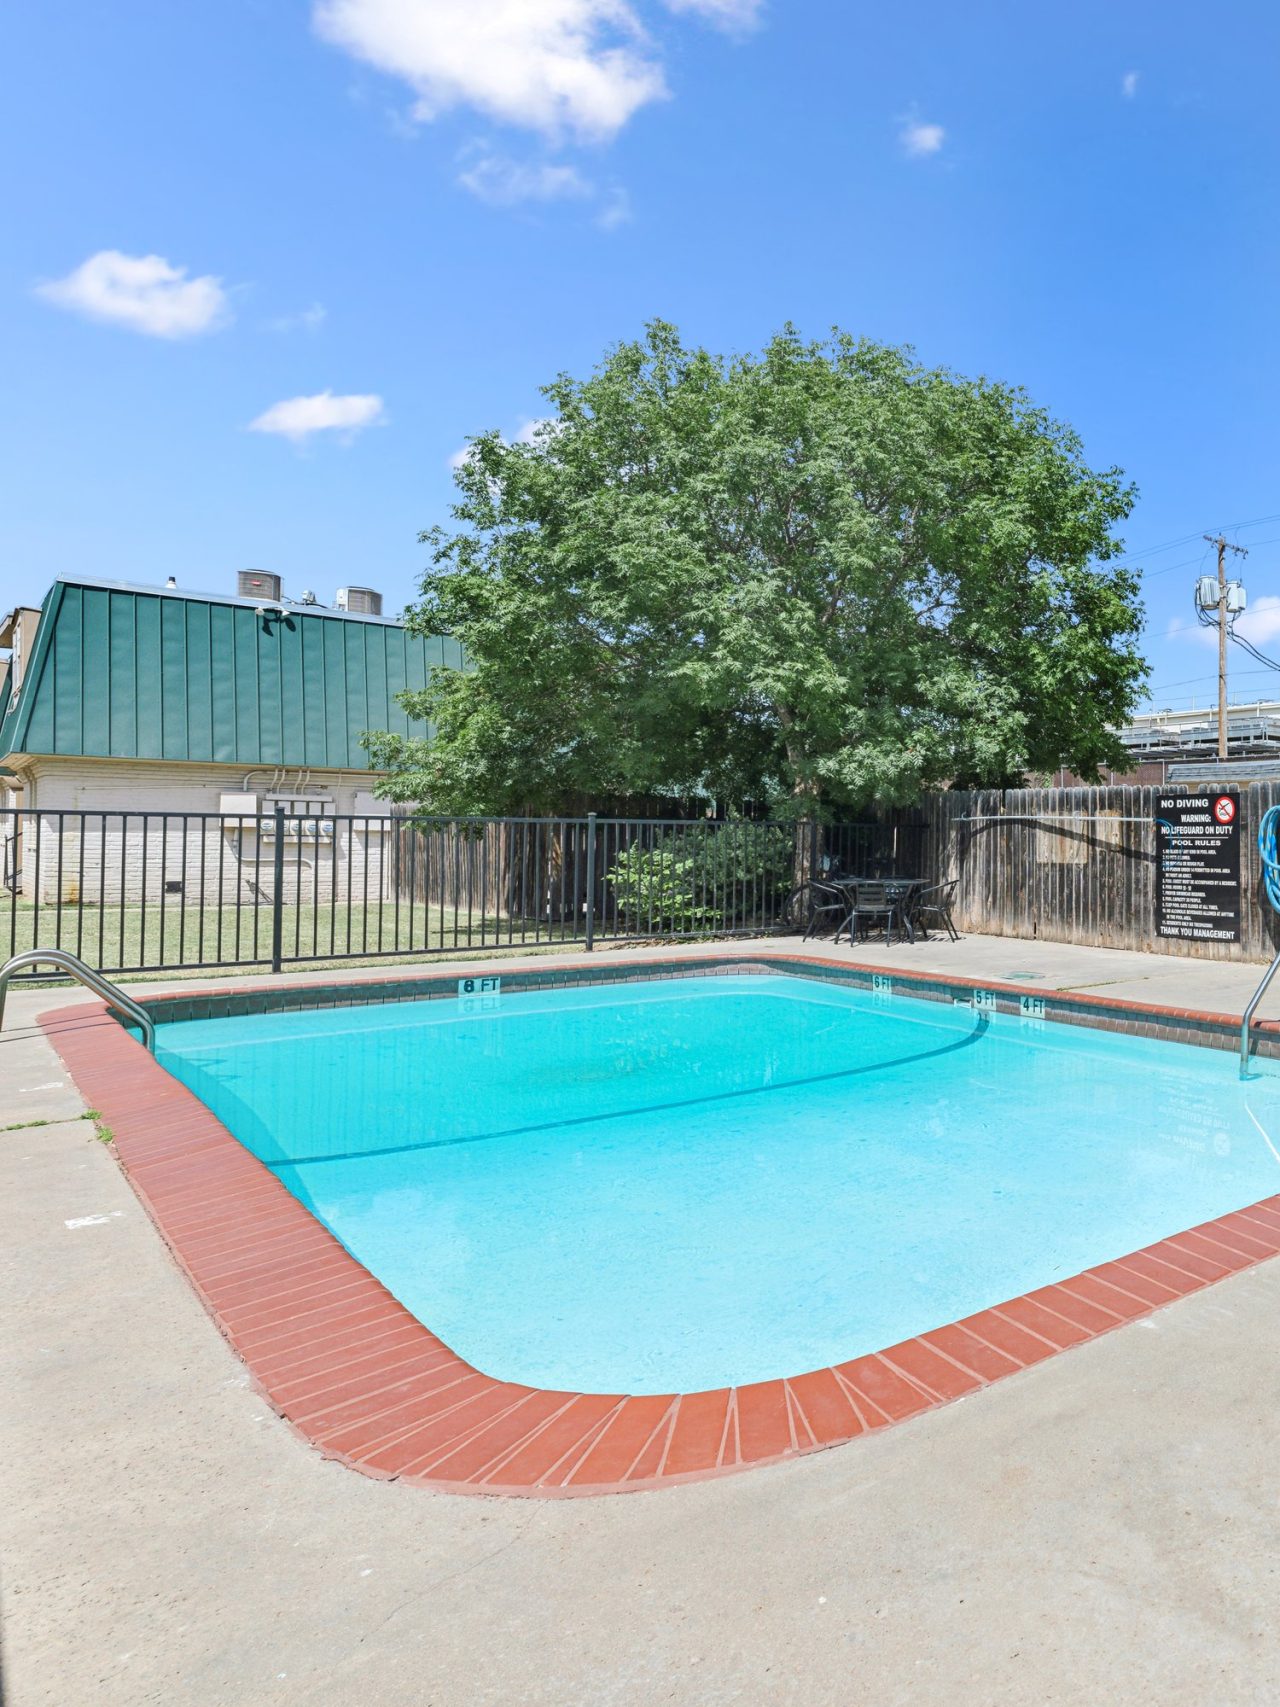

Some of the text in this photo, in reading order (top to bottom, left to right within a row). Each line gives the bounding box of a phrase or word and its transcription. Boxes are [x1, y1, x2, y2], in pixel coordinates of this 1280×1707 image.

[1161, 799, 1209, 808] NO DIVING
[1181, 814, 1211, 822] WARNING:
[1161, 826, 1233, 834] NO LIFEGUARD ON DUTY
[1160, 926, 1235, 940] THANK YOU MANAGEMENT
[464, 978, 499, 993] 8 FT
[874, 976, 889, 990] 6 FT
[976, 990, 994, 1006] 5 FT
[1023, 997, 1044, 1014] 4 FT
